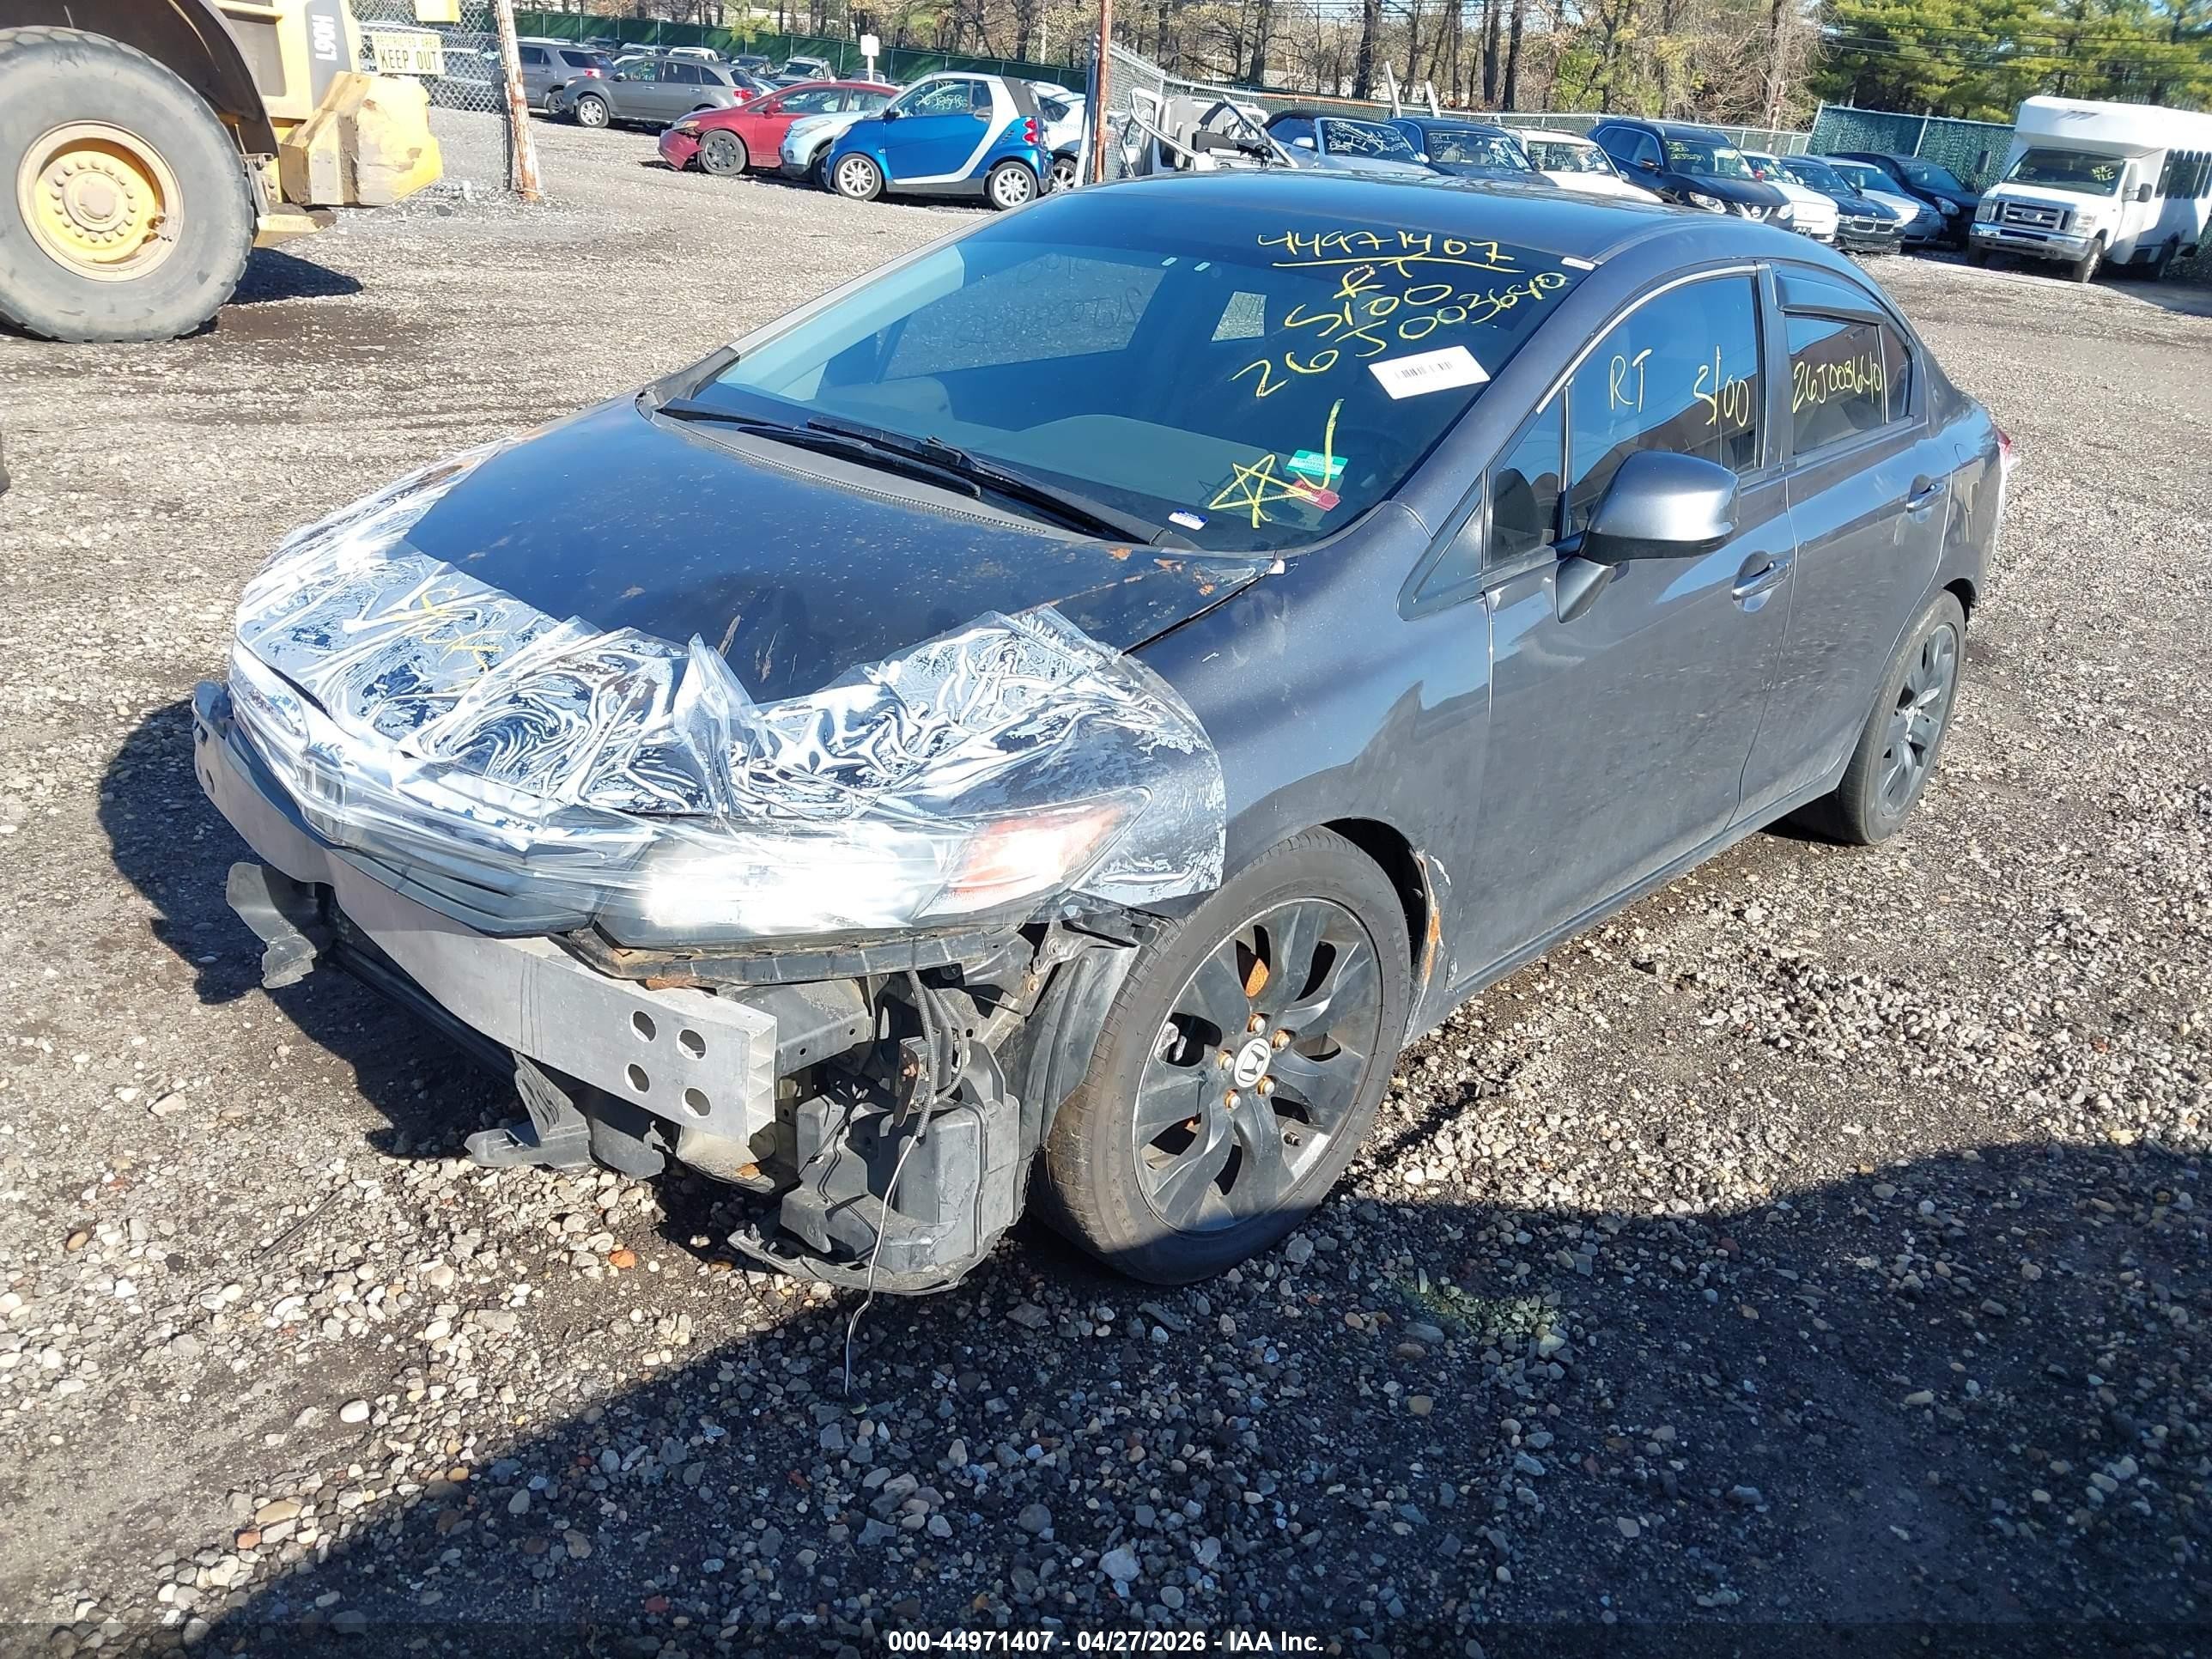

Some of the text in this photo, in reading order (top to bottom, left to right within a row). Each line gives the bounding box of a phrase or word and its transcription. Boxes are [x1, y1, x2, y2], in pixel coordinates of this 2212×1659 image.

[380, 49, 438, 70] KEEP OUT
[2091, 165, 2112, 176] NYC
[2094, 172, 2116, 182] TLC
[1257, 230, 1516, 265] 44971407
[1609, 348, 1653, 414] RT
